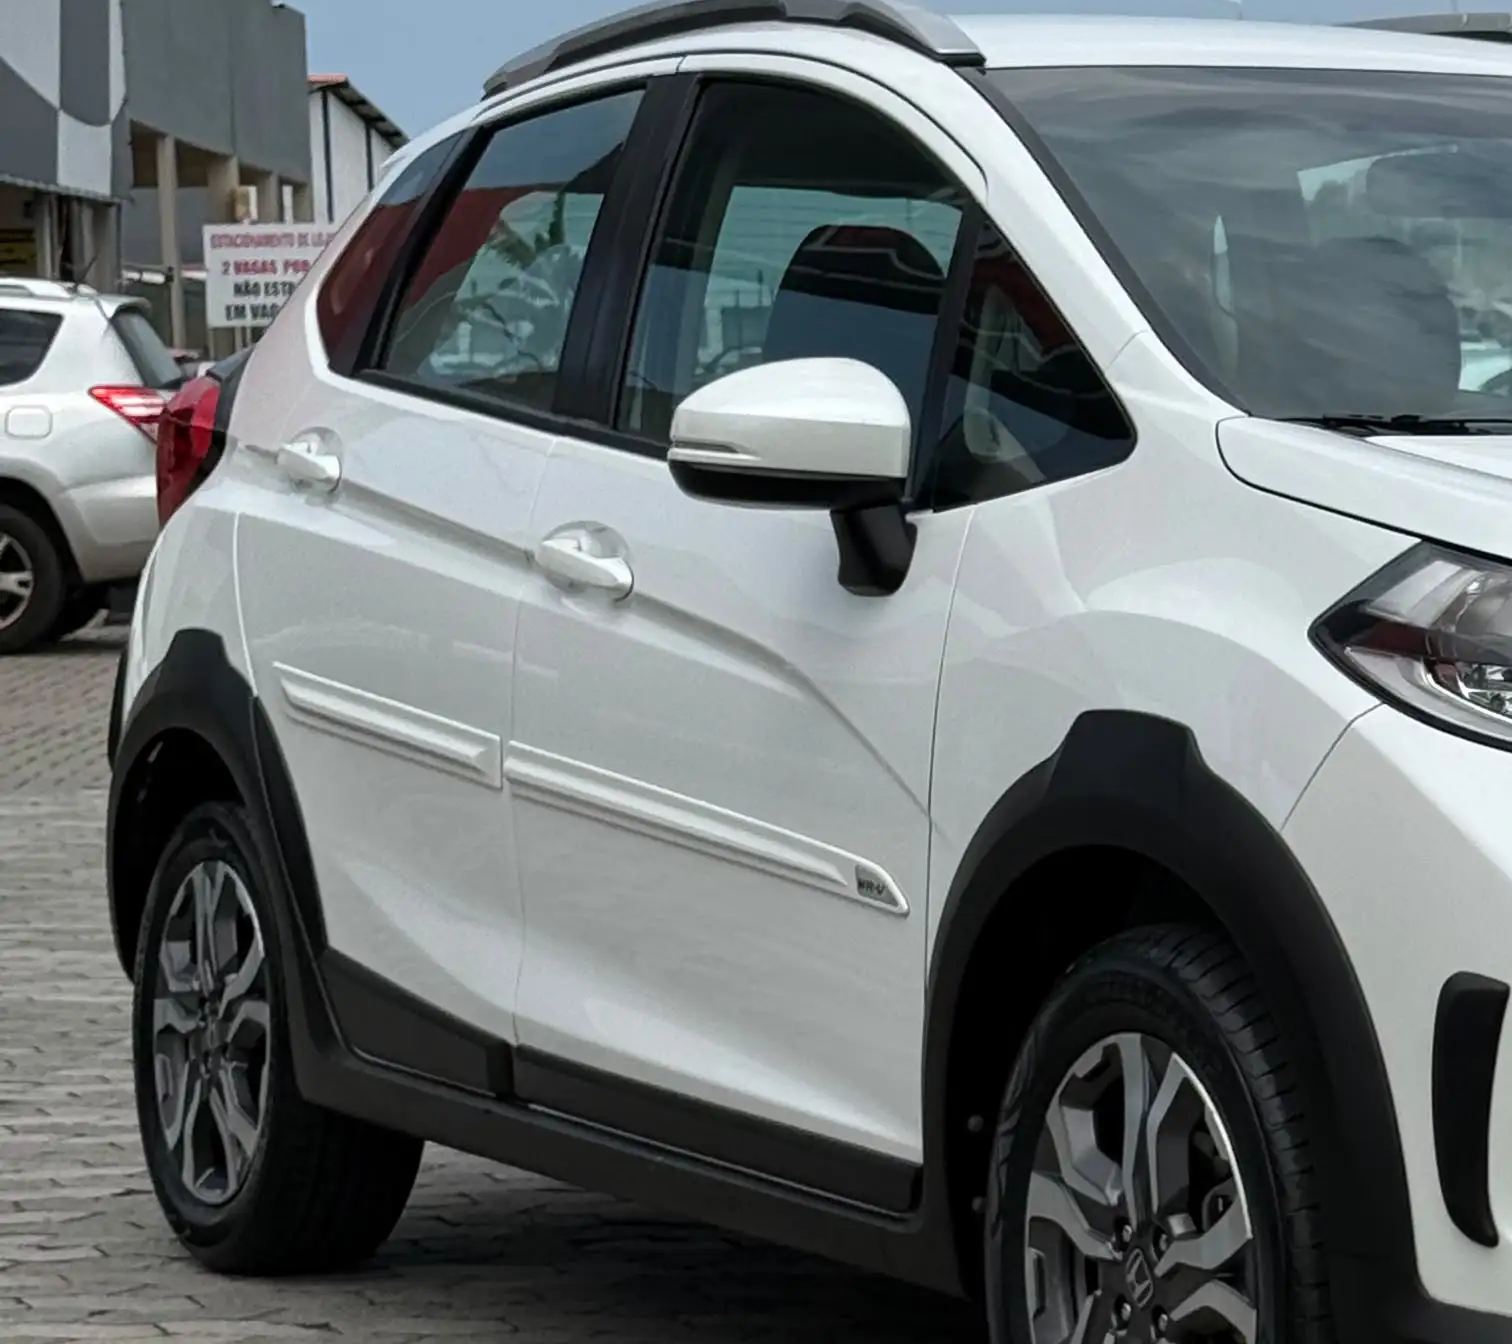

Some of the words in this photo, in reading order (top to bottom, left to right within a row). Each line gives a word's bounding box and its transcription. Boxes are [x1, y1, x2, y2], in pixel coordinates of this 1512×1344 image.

[297, 232, 310, 247] DE
[221, 261, 231, 275] 2
[233, 260, 277, 275] VAGAS
[234, 280, 261, 296] NÃO
[225, 304, 246, 321] EM
